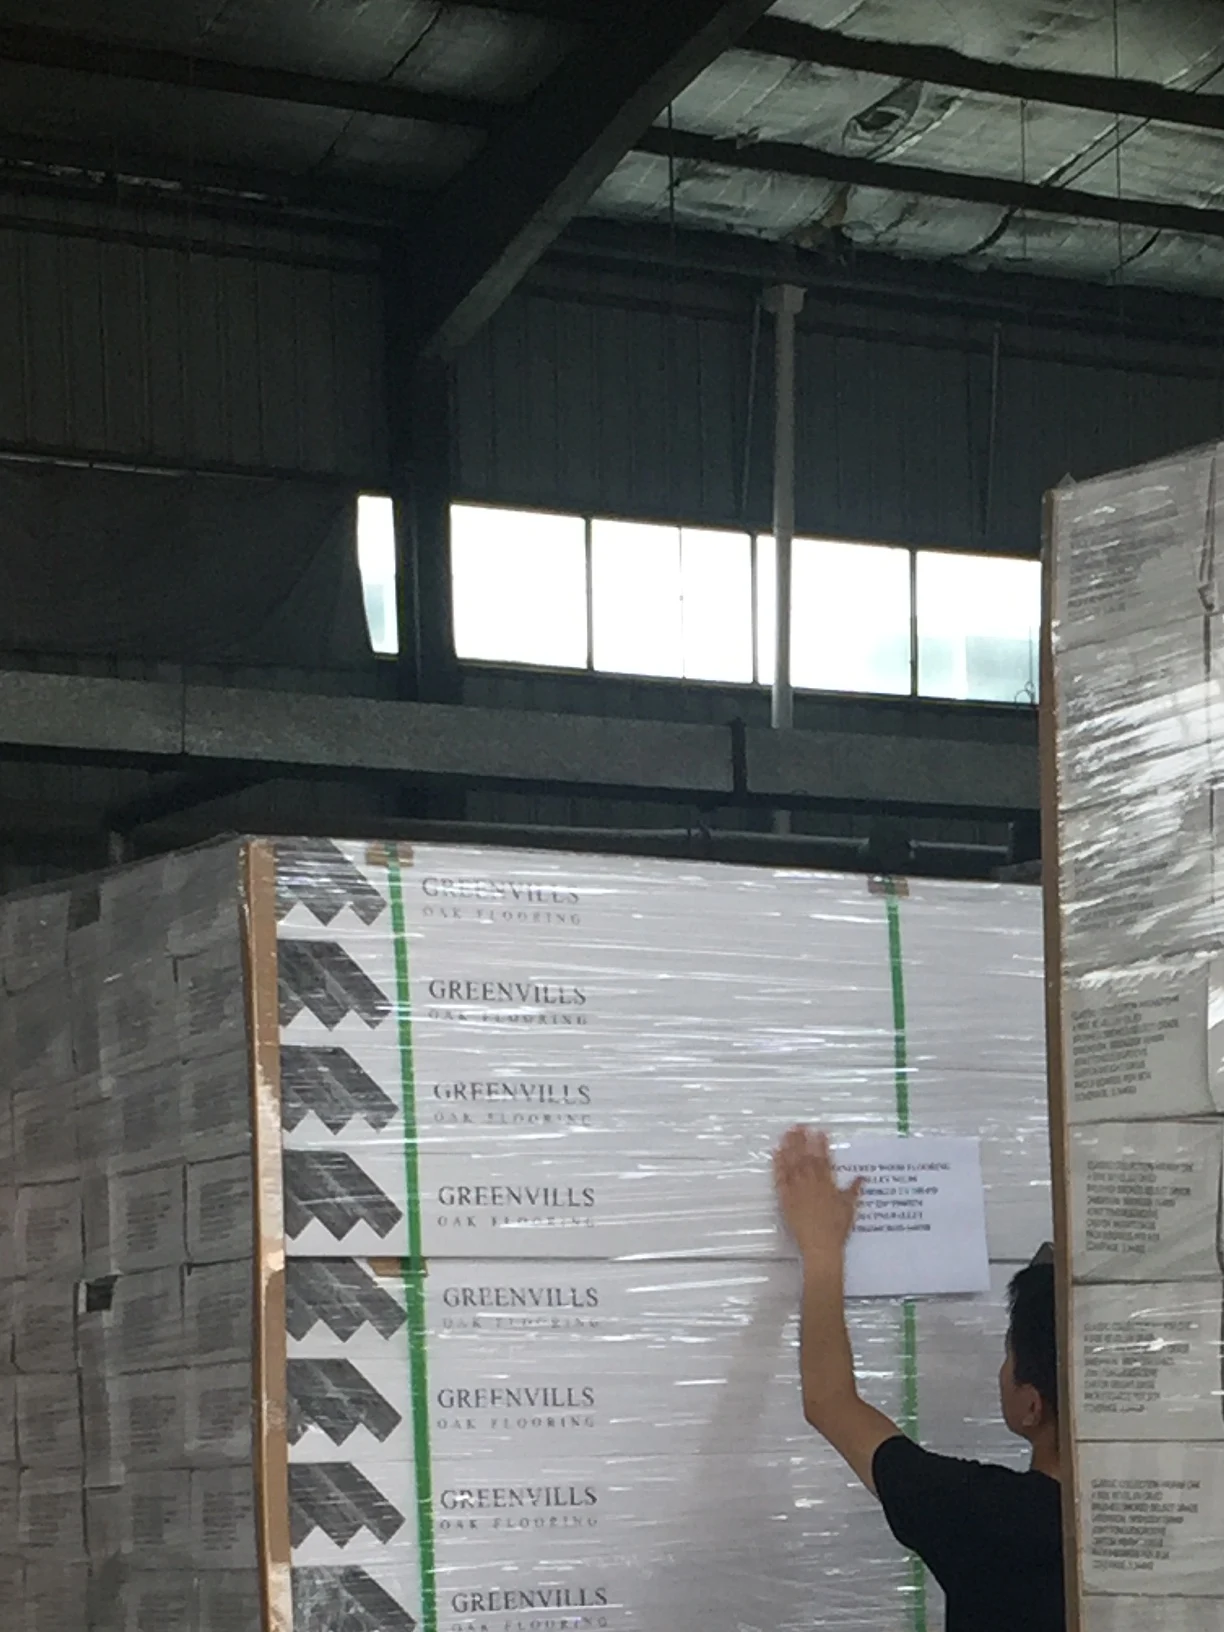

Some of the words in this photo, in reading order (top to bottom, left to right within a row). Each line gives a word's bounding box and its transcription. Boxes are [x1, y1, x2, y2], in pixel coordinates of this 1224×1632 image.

[428, 980, 588, 1006] GREENVILLS
[433, 1081, 592, 1105] GREENVILLS
[438, 1187, 596, 1208] GREENVILLS
[443, 1288, 600, 1308] GREENVILLS
[437, 1387, 596, 1409] GREENVILLS
[437, 1418, 477, 1429] OAK
[490, 1416, 596, 1429] FLOORING
[440, 1487, 598, 1511] GREENVILLS
[451, 1588, 608, 1614] GREENVILLS
